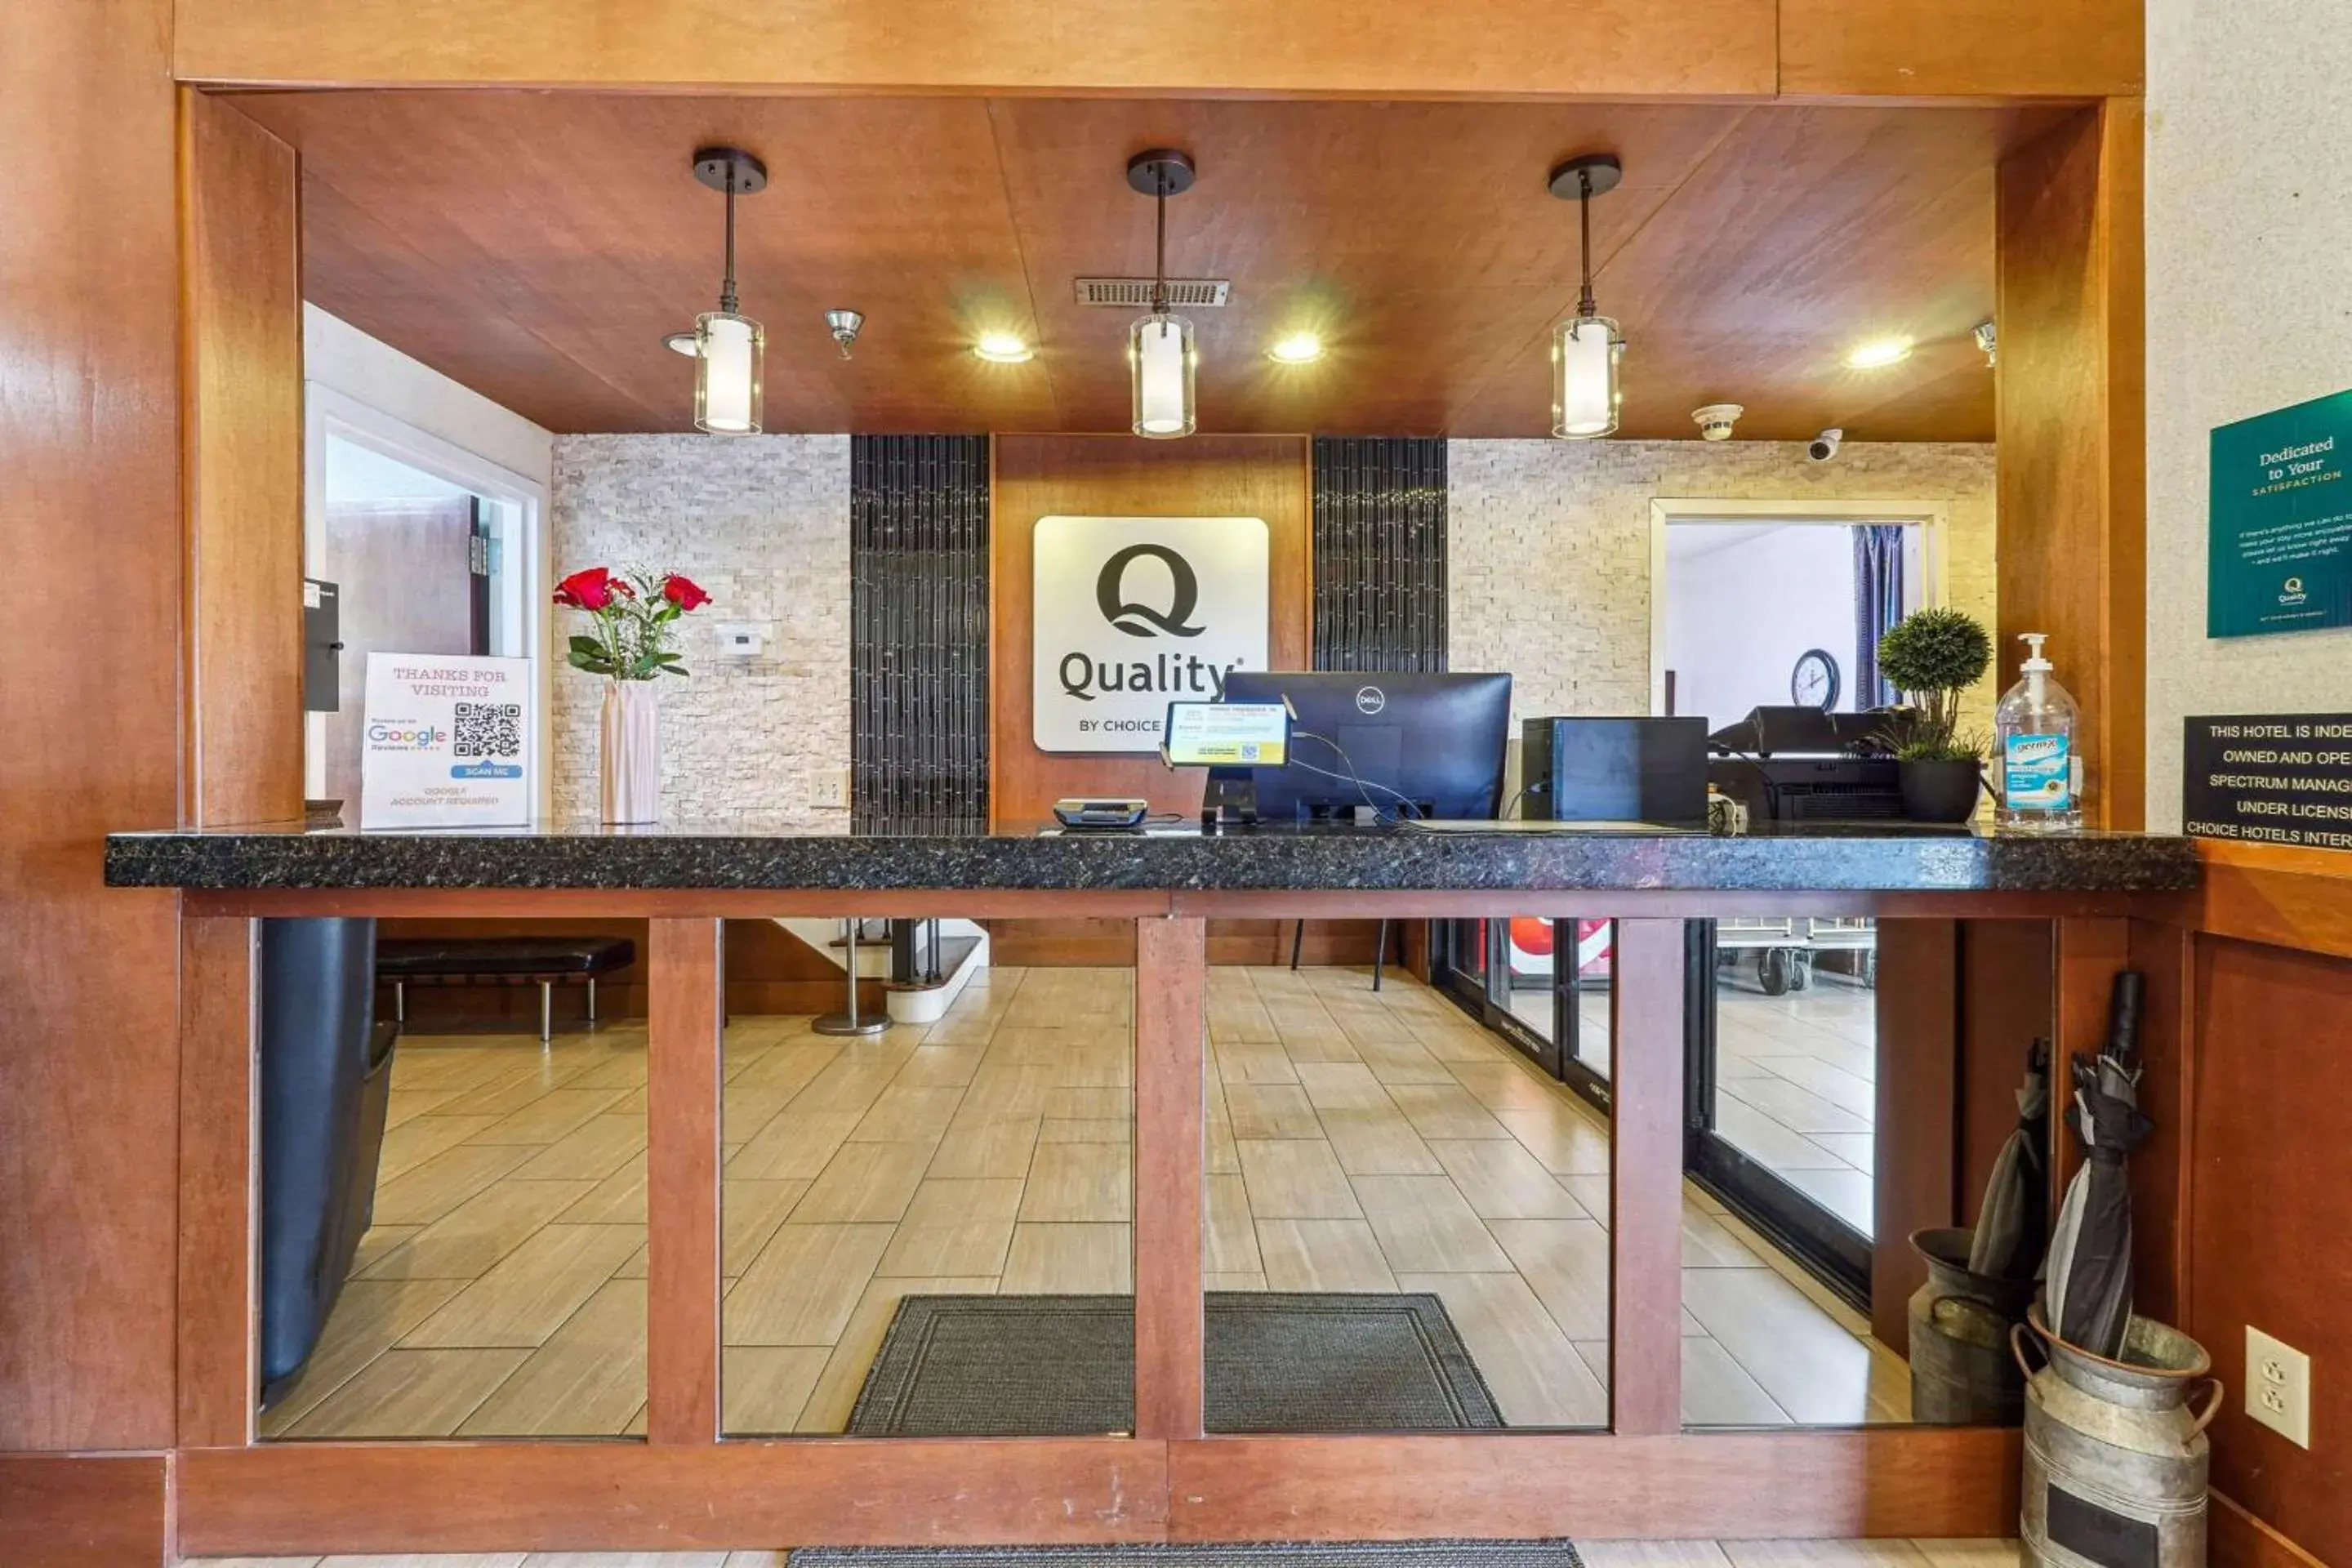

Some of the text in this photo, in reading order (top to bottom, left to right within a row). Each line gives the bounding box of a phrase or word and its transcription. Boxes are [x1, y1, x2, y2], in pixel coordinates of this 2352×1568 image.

[2259, 435, 2333, 466] Dedicated
[2268, 459, 2324, 480] to Your
[2252, 470, 2342, 496] SATISFACTION
[2278, 593, 2306, 603] Quality
[393, 667, 507, 683] THANKS FOR
[411, 684, 490, 697] VISITING
[1361, 696, 1381, 704] DELL
[1080, 720, 1161, 732] BY CHOICE
[2209, 724, 2352, 737] THIS HOTEL IS INDE
[368, 725, 447, 746] Google
[2223, 751, 2277, 763] OWNED
[2279, 752, 2313, 764] AND
[465, 768, 509, 776] SCAN ME
[2209, 774, 2352, 792] SPECTRUM MANAG
[390, 797, 500, 806] ACCOUNT REQUIRED
[2236, 800, 2288, 815] UNDER
[2187, 822, 2352, 847] CHOICE HOTELS INTER
